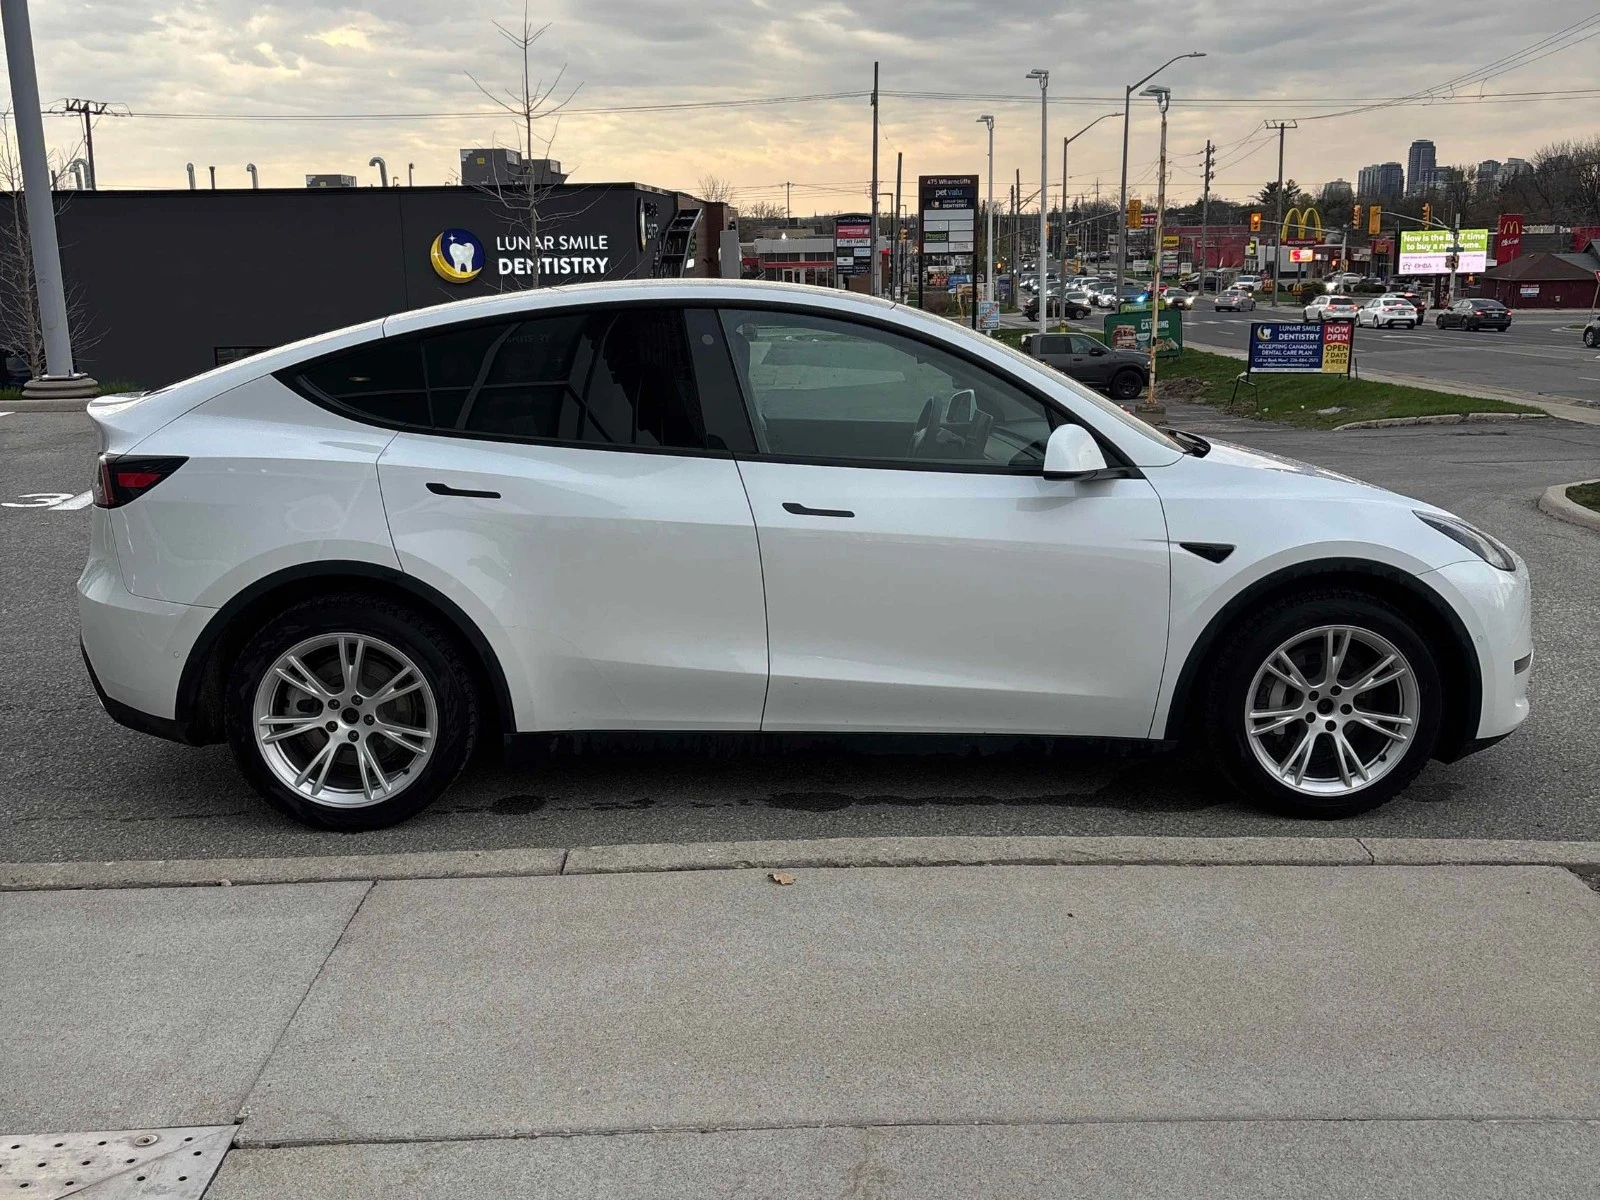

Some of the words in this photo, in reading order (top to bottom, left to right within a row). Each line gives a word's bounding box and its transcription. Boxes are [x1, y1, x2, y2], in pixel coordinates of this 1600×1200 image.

[935, 188, 947, 198] pet
[948, 188, 963, 196] valu
[1404, 234, 1421, 242] Now
[1422, 233, 1429, 241] is
[1430, 233, 1444, 241] the
[1467, 232, 1486, 240] time
[496, 235, 555, 251] LUNAR
[558, 235, 609, 250] SMILE
[1416, 242, 1431, 251] buy
[498, 257, 609, 275] DENTISTRY
[1141, 320, 1169, 330] CATING
[1327, 326, 1349, 334] NOW
[1325, 344, 1349, 352] OPEN
[1, 492, 75, 508] 3
